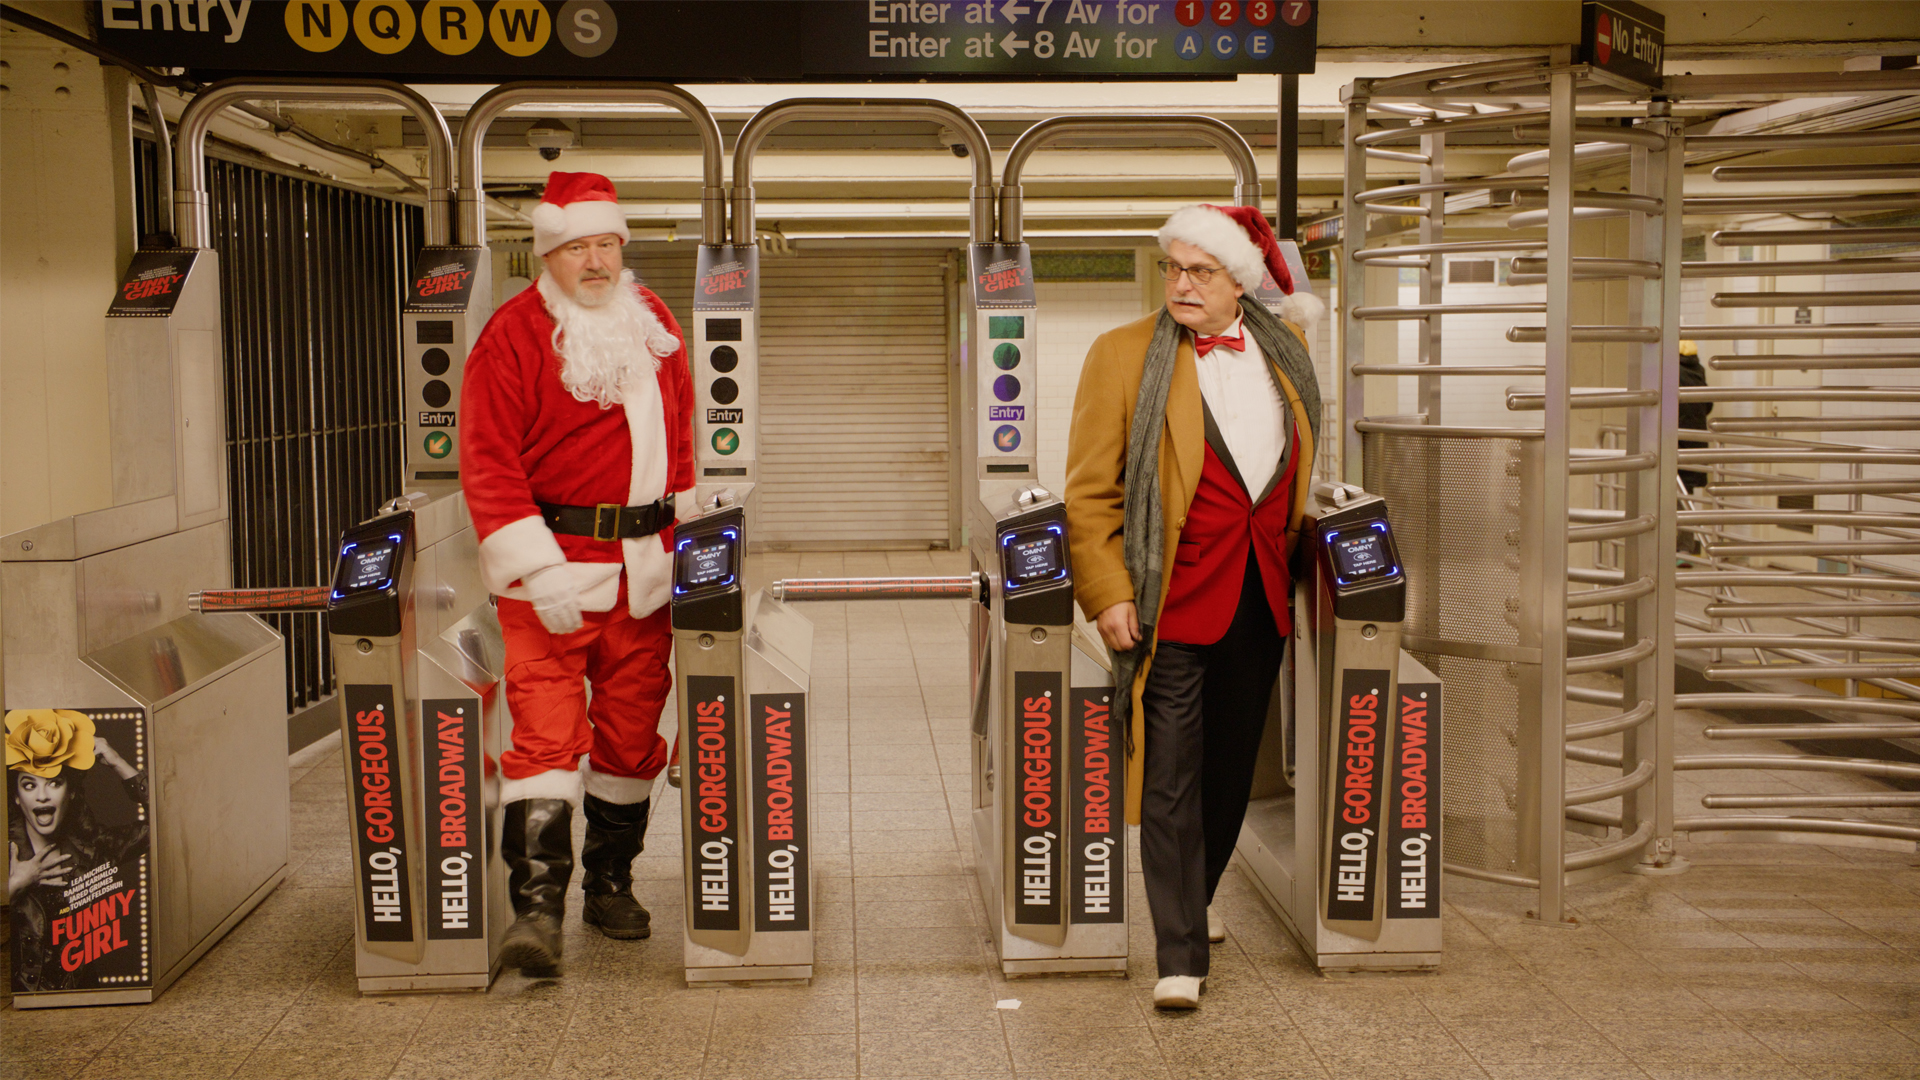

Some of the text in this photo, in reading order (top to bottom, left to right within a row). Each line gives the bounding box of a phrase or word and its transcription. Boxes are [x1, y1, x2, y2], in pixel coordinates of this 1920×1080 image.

[102, 0, 602, 44] Entry N Q R W S
[869, 0, 1303, 24] Enter at 7 Av for 1 2 3 7
[869, 30, 1267, 58] Enter at 8 Av for A C E
[1612, 17, 1662, 73] No Entry
[123, 274, 184, 292] FUNNY
[416, 271, 472, 288] FUNNY
[419, 280, 463, 297] GIRL
[699, 269, 752, 287] FUNNY
[704, 278, 746, 295] GIRL
[978, 267, 1028, 284] FUNNY
[984, 276, 1025, 293] GIRL
[125, 284, 172, 300] GIRL
[420, 413, 455, 426] Entry
[707, 410, 742, 423] Entry
[990, 407, 1024, 420] Entry
[360, 555, 386, 565] OMNY
[696, 551, 722, 561] OMNY
[1022, 546, 1048, 556] OMNY
[1347, 543, 1373, 553] OMNY
[696, 694, 734, 911] HELLO, GORGEOUS.
[1023, 690, 1057, 905] HELLO, GORGEOUS.
[1084, 695, 1115, 913] HELLO, BROADWAY.
[1337, 688, 1379, 902] HELLO, GORGEOUS.
[1400, 691, 1432, 909] HELLO, BROADWAY.
[355, 703, 402, 922] HELLO, GORGEOUS.
[437, 707, 473, 929] HELLO, BROADWAY.
[765, 702, 799, 921] HELLO, BROADWAY.
[63, 866, 119, 898] RAMIN KARIMLOO
[71, 861, 111, 887] LEA MICHELE
[59, 880, 123, 914] AND TOVAH FELDSHUH
[69, 876, 114, 904] JARED GRIMES
[52, 889, 136, 946] FUNNY
[60, 919, 128, 972] GIRL
